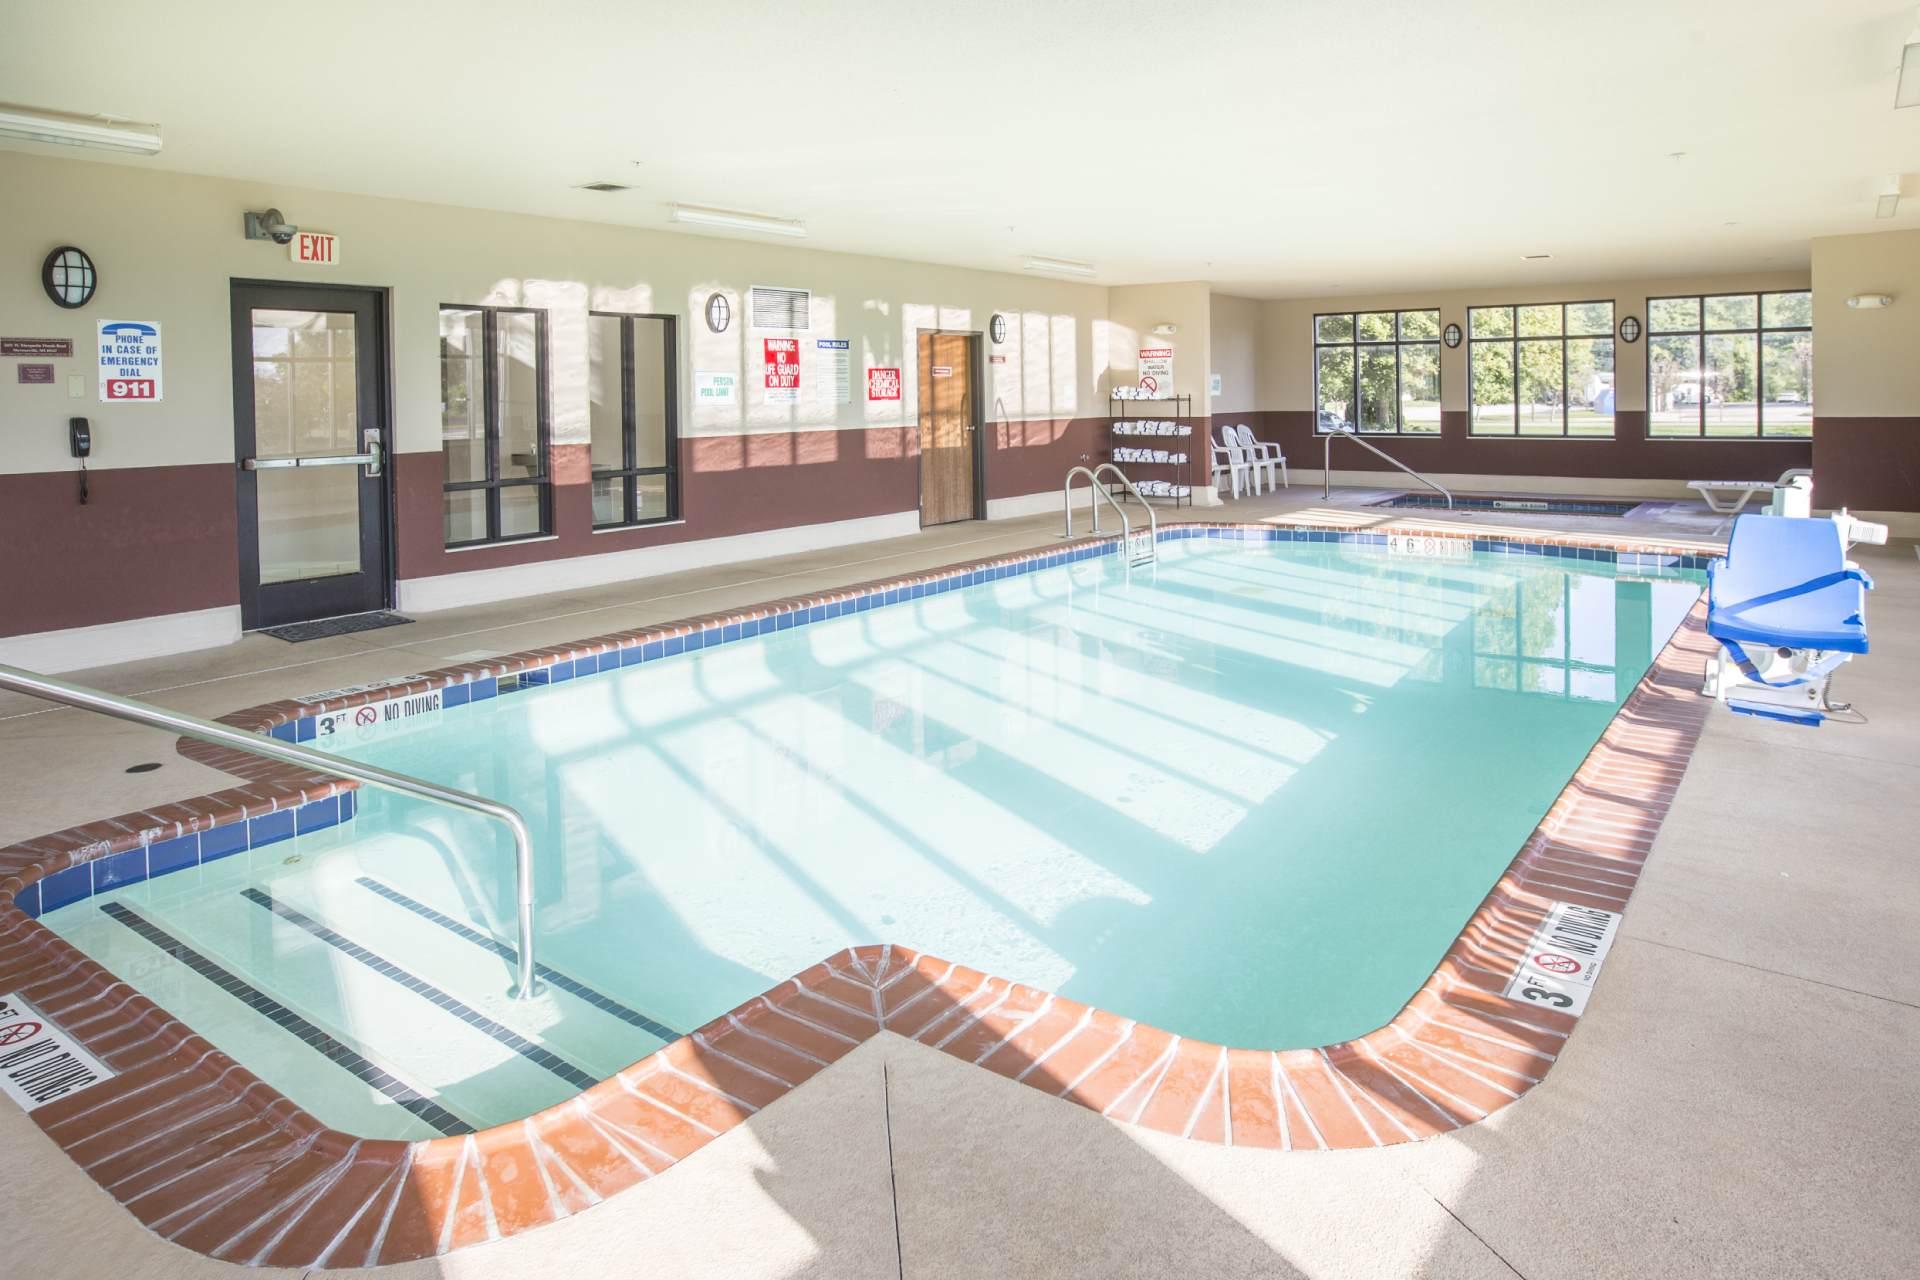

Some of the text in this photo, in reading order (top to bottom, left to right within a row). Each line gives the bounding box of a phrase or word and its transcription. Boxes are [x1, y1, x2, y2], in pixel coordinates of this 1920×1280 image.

[300, 234, 334, 262] EXIT
[115, 335, 144, 343] PHONE
[102, 345, 157, 354] IN CASE OF
[767, 339, 796, 352] WARNING:
[777, 352, 786, 364] NO
[1141, 350, 1170, 358] WARNING
[101, 356, 158, 366] EMERGENCY
[120, 368, 141, 376] DIAL
[777, 364, 799, 376] GUARD
[872, 370, 896, 380] DANGER
[769, 376, 795, 387] ON DUTY
[869, 379, 899, 389] CHEMICAL
[113, 381, 150, 397] 911
[701, 388, 714, 396] POOL
[871, 388, 898, 397] STORAGE
[320, 694, 439, 736] 3 FT NO DIVING
[1555, 906, 1612, 941] DIVING
[1546, 935, 1599, 956] NO
[1521, 987, 1574, 1008] 3
[0, 1038, 60, 1069] NO
[8, 1052, 98, 1103] DIVING
